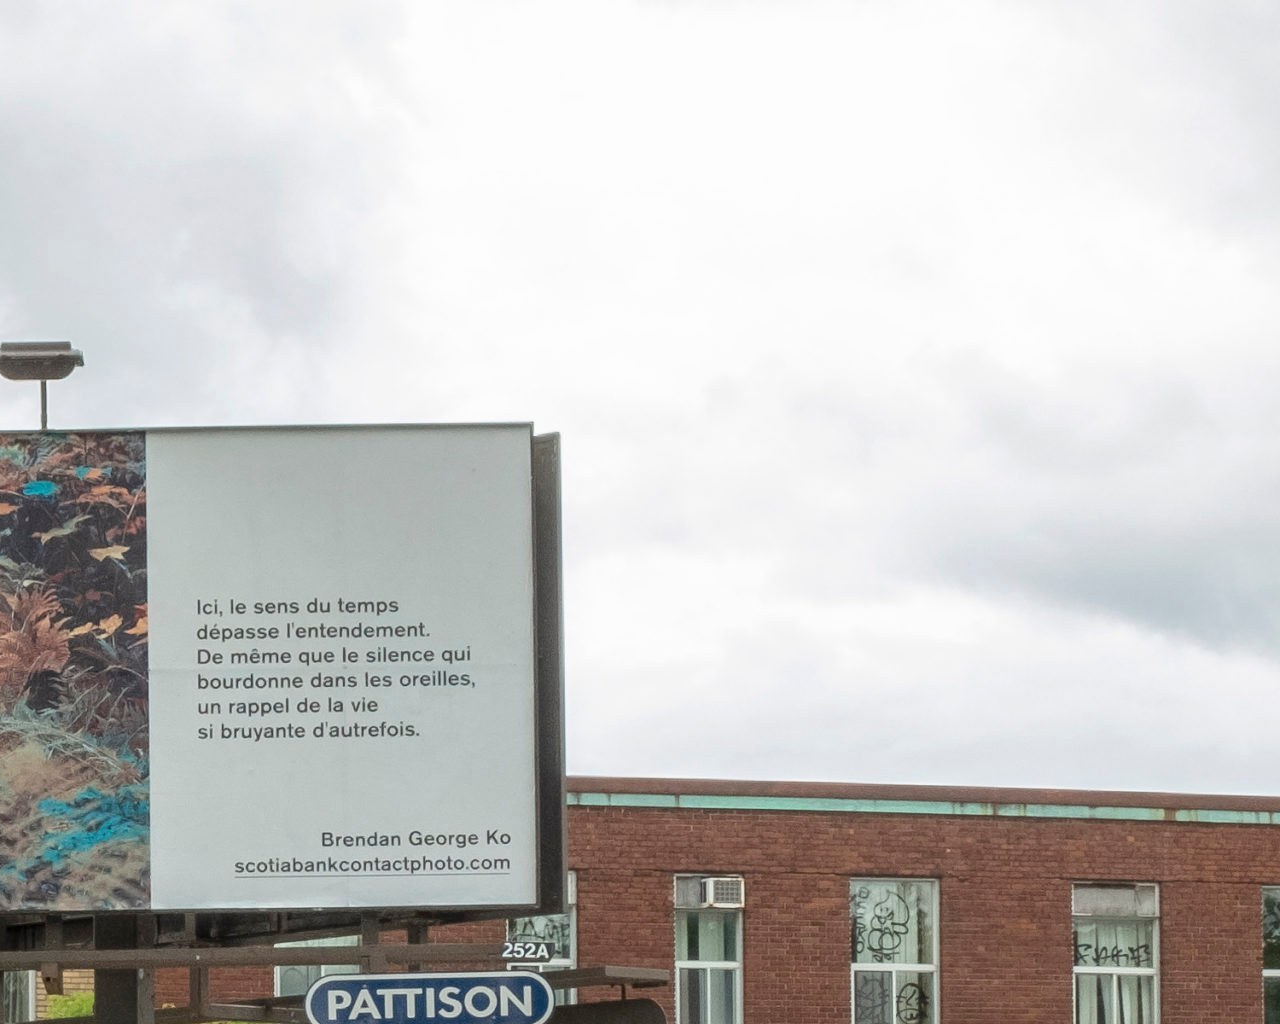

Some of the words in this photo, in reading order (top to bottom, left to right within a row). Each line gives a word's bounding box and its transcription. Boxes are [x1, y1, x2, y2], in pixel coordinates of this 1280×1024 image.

[197, 599, 223, 617] Ici,
[230, 599, 247, 615] le
[253, 601, 300, 615] sens
[306, 597, 331, 614] du
[337, 597, 399, 617] temps
[196, 623, 280, 643] dépasse
[286, 622, 430, 639] l'entendement.
[197, 648, 224, 665] De
[230, 648, 292, 664] même
[298, 651, 335, 667] que
[342, 647, 359, 664] le
[365, 646, 435, 663] silence
[441, 645, 471, 665] qui
[197, 673, 304, 690] bourdonne
[310, 672, 358, 688] dans
[364, 671, 393, 688] les
[399, 670, 476, 688] oreilles,
[198, 702, 221, 715] un
[228, 697, 289, 717] rappel
[296, 697, 321, 714] de
[328, 697, 344, 713] la
[351, 696, 378, 713] vie
[198, 723, 213, 740] si
[221, 723, 306, 742] bruyante
[312, 721, 420, 738] d'autrefois.
[321, 831, 401, 848] Brendan
[408, 830, 479, 849] George
[486, 829, 512, 845] Ko
[234, 855, 511, 875] scotiabankcontactphoto.com
[501, 942, 550, 959] 252A
[326, 985, 533, 1021] PATTISON
